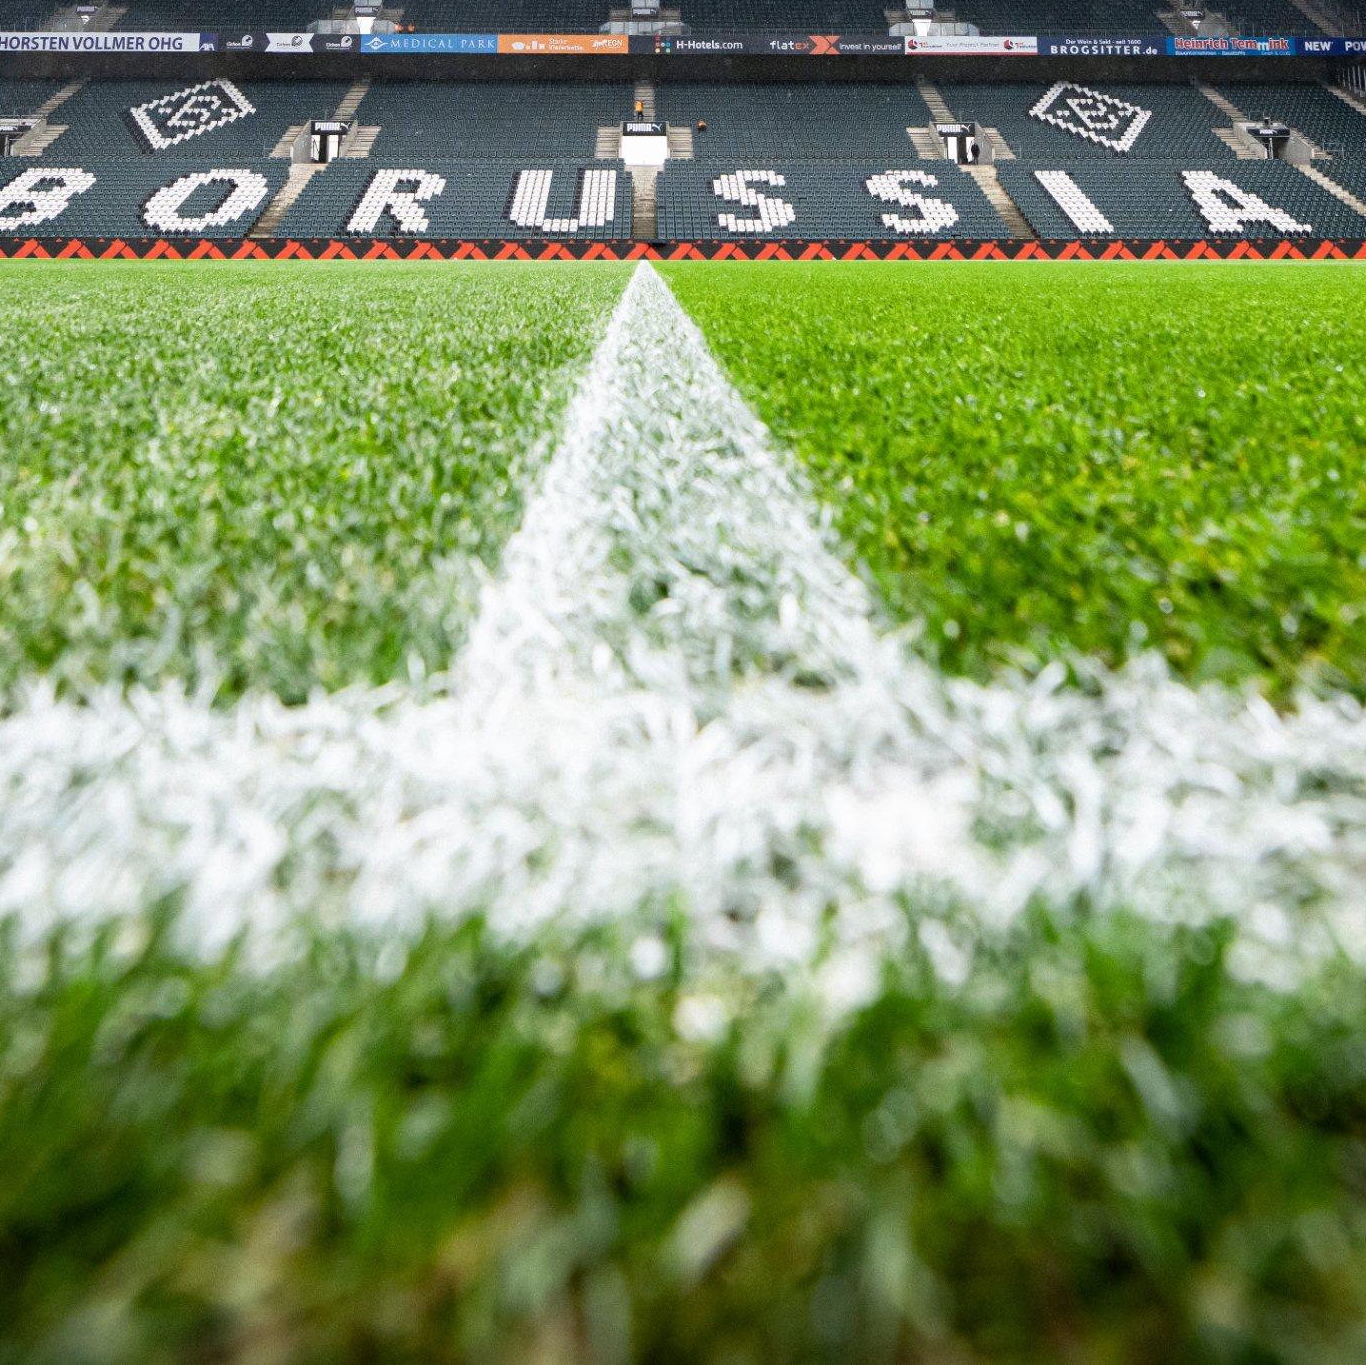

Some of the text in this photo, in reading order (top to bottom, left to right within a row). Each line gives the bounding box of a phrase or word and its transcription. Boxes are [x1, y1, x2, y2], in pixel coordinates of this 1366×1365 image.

[73, 36, 147, 50] VOLLMER
[149, 36, 183, 50] OHG
[390, 39, 495, 48] MEDICAL PARK
[676, 40, 743, 50] H-Hotels.com
[1304, 42, 1331, 51] NEW
[314, 122, 340, 131] PUMA
[626, 123, 652, 132] PUMA
